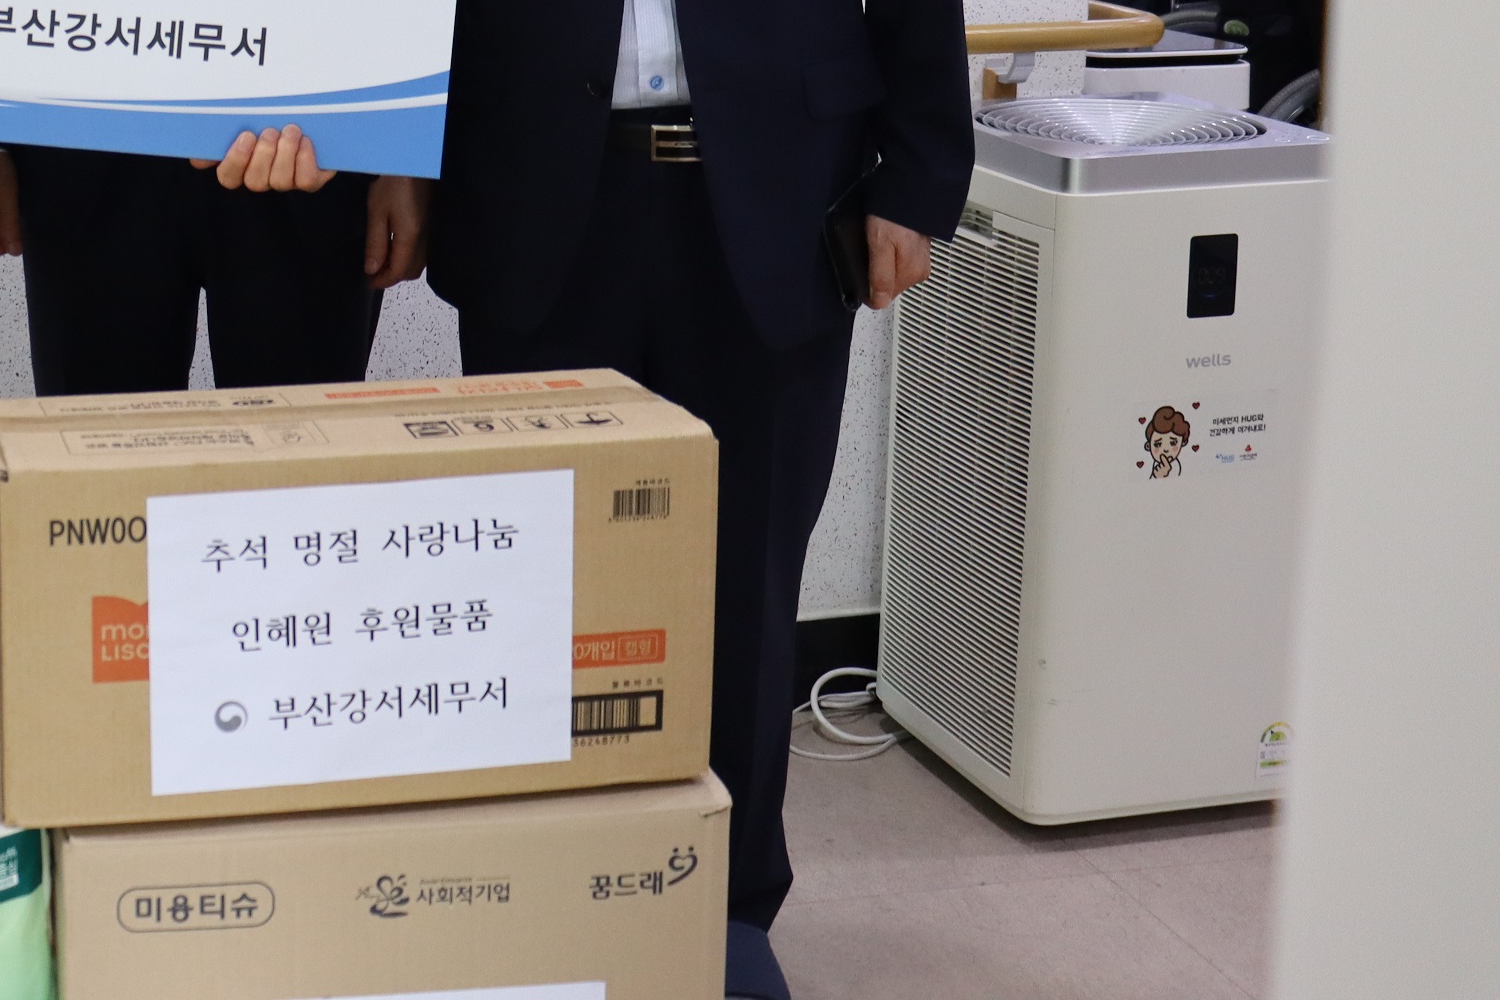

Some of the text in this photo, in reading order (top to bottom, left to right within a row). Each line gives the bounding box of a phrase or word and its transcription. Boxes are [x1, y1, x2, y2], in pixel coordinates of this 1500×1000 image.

[1185, 353, 1232, 369] wells
[1209, 423, 1267, 437] 건강하게 이겨내요!
[1212, 413, 1264, 426] 미세먼지 HUG와
[201, 517, 520, 573] 추석 명절 사랑나눔
[231, 599, 493, 653] 인혜원 후원물품
[267, 676, 509, 732] 부산강서세무서
[416, 882, 511, 907] 사회적기업
[588, 870, 664, 902] 꿈드래
[133, 889, 260, 923] 미용티슈
